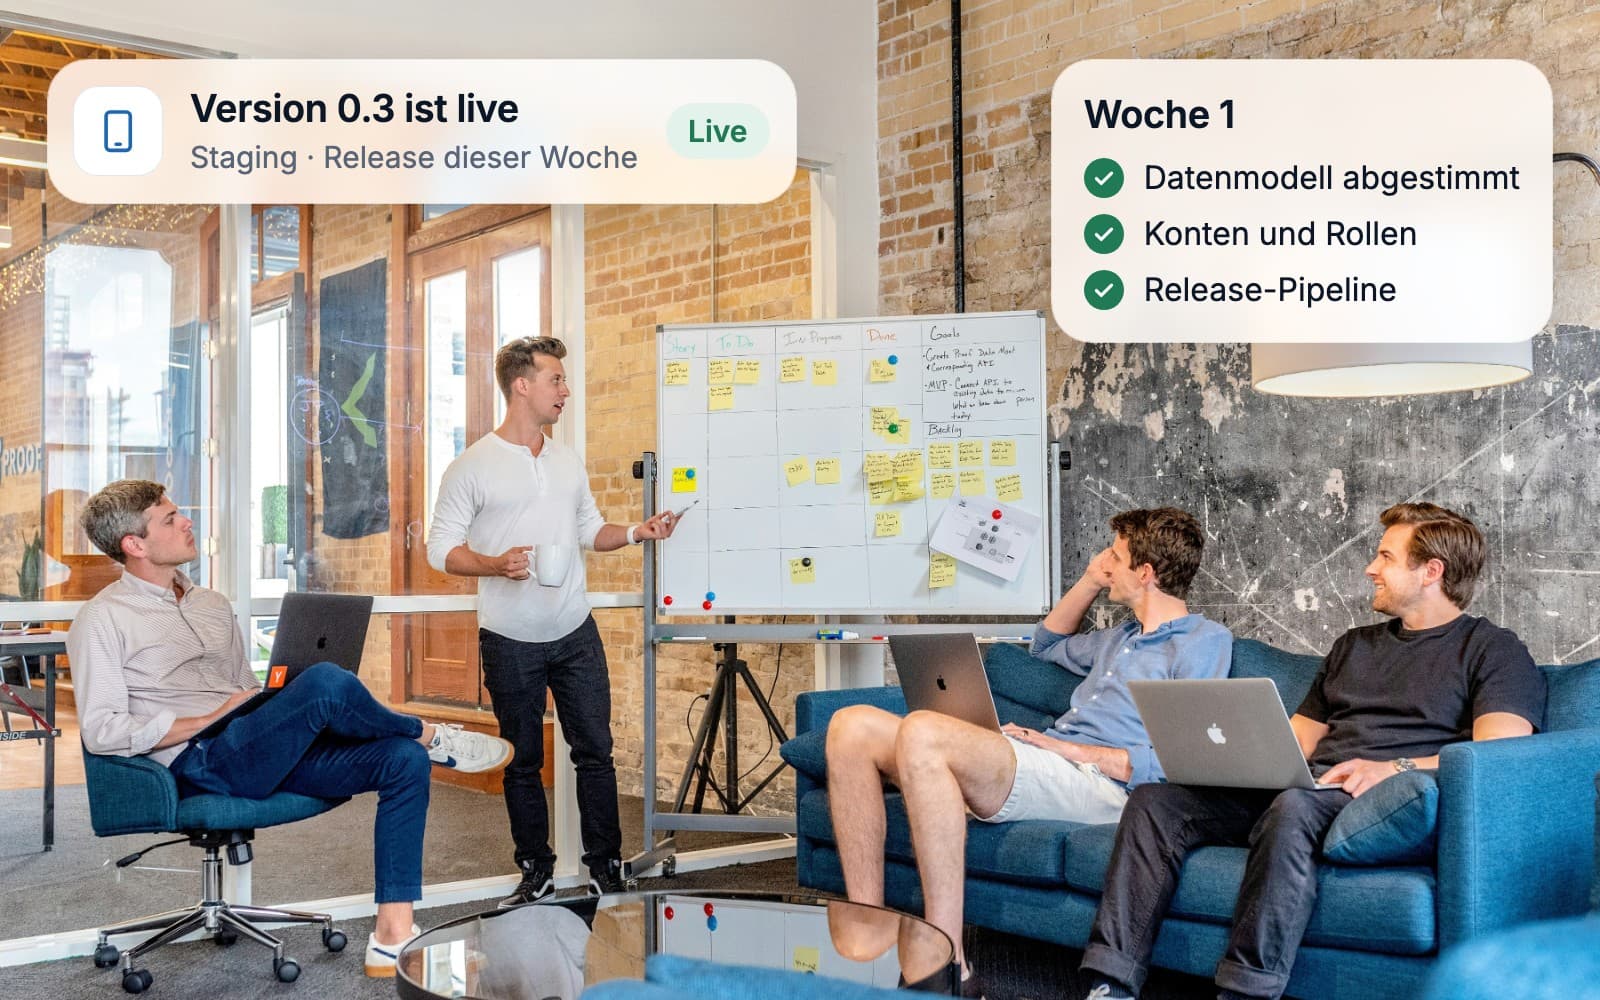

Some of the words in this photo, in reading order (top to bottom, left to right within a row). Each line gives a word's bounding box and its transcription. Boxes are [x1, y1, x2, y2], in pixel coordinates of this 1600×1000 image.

[866, 329, 897, 343] Done
[930, 325, 960, 341] Goals
[666, 334, 696, 353] Story
[715, 333, 733, 351] To
[736, 334, 754, 349] Do
[928, 424, 962, 438] Backlog
[0, 732, 27, 741] SIDE
